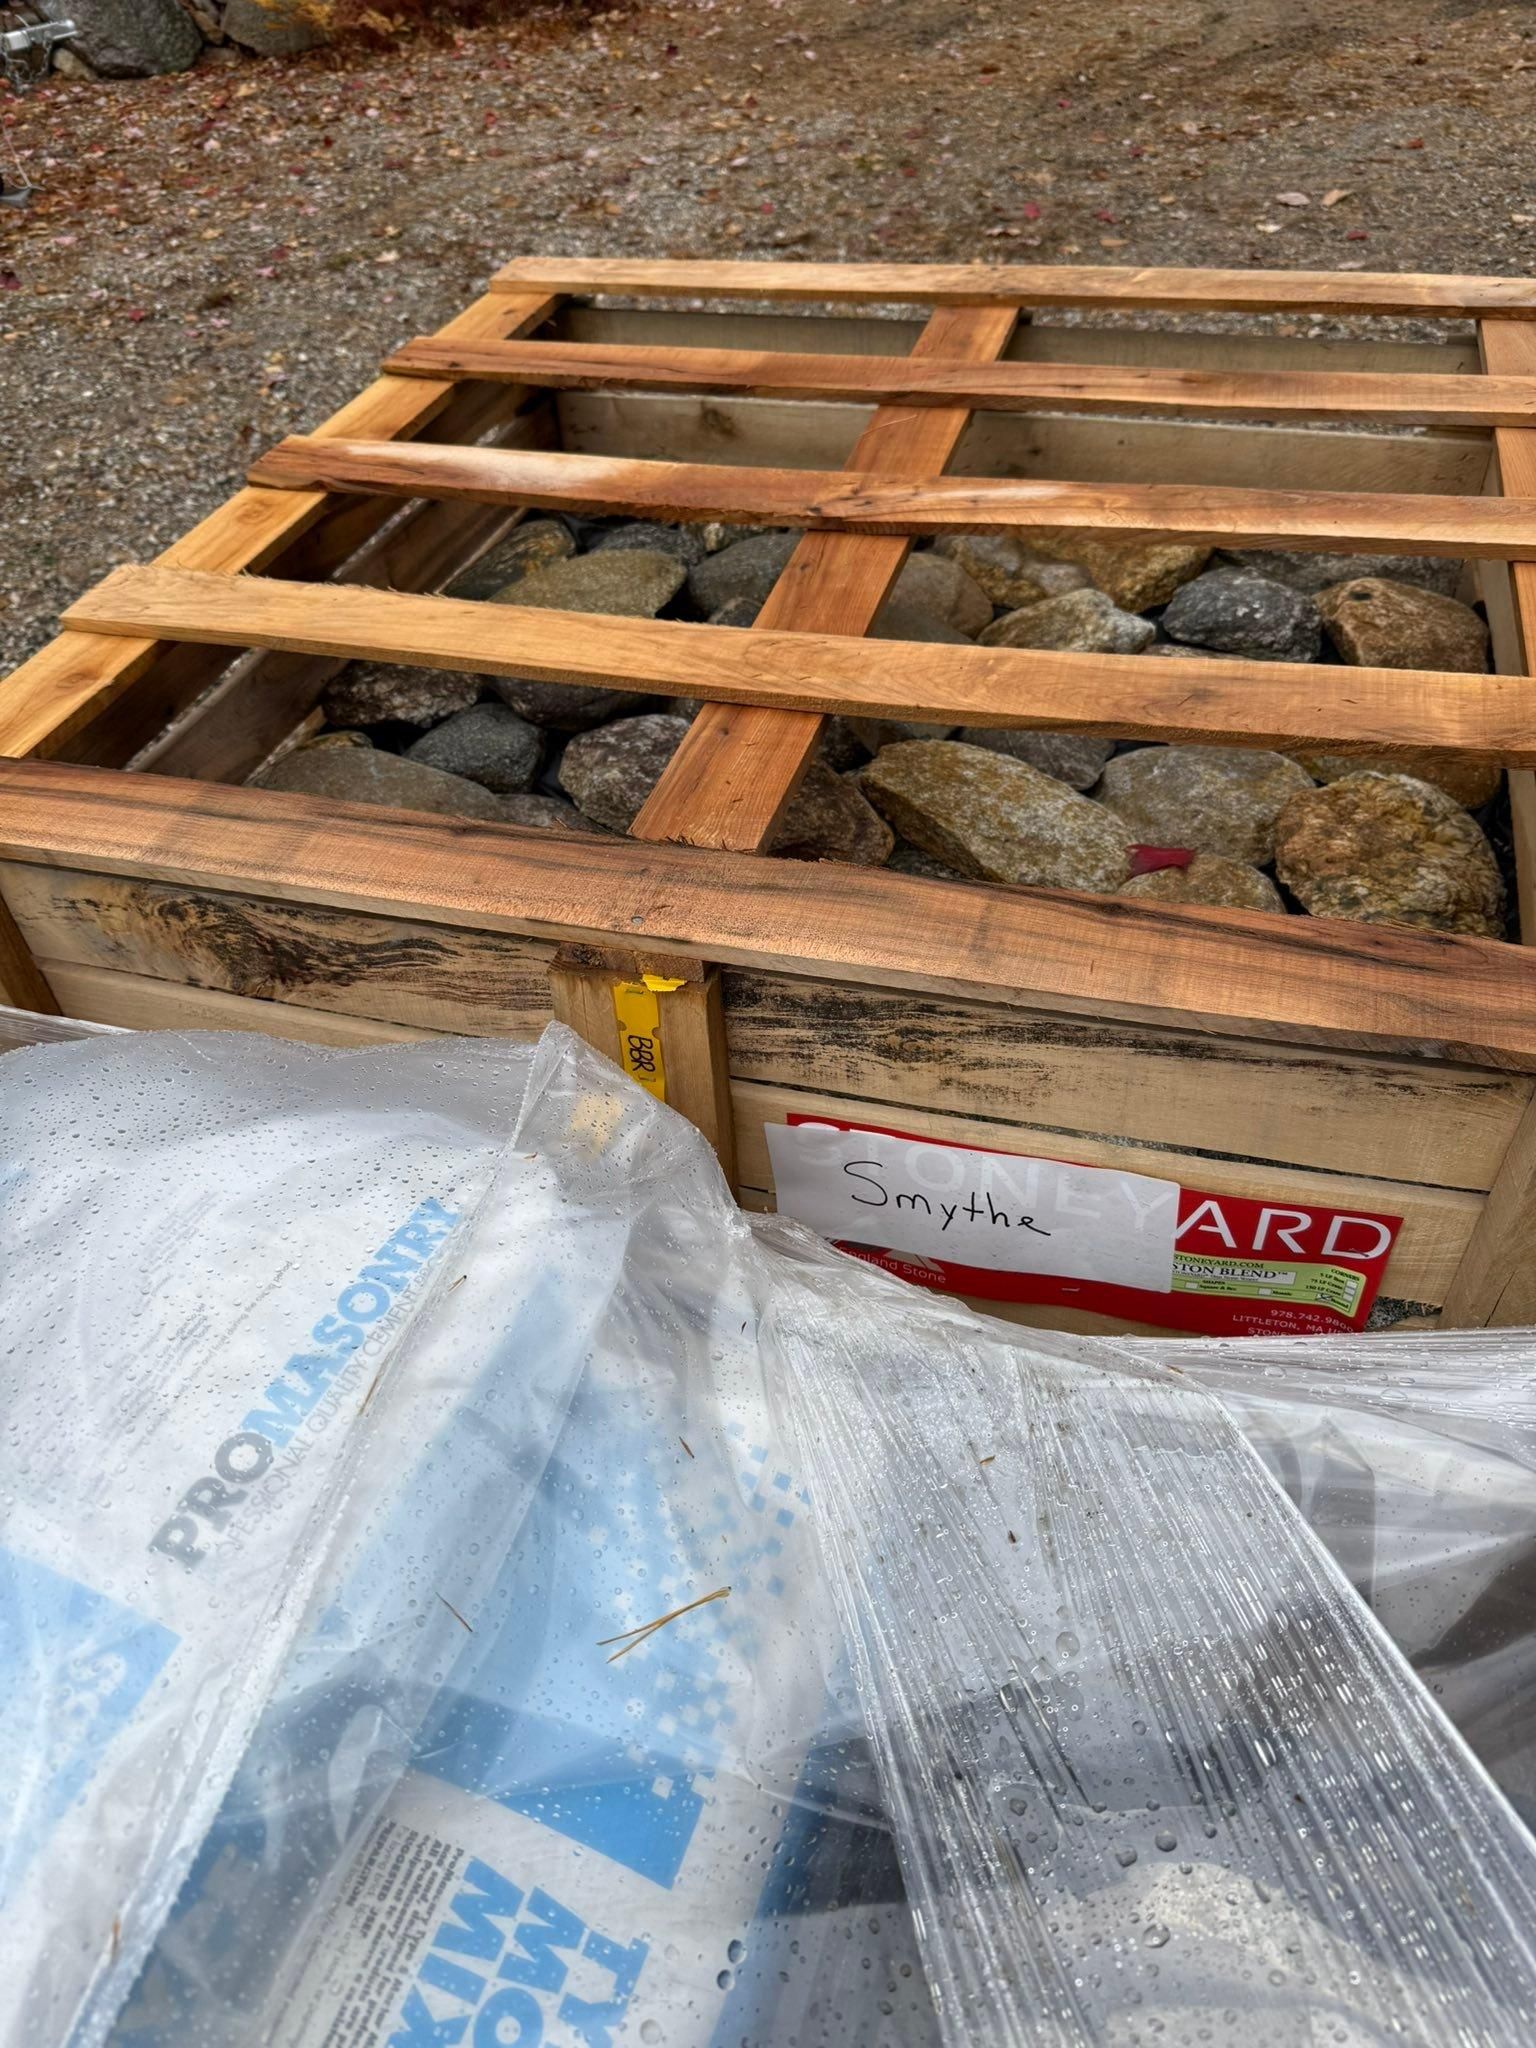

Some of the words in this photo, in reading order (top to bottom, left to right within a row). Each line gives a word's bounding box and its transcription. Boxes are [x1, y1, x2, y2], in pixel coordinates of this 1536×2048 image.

[844, 1160, 1051, 1237] Smythe
[902, 1263, 947, 1284] Stone
[1172, 1263, 1216, 1276] STON
[1330, 1268, 1360, 1280] CORNERS
[1232, 1314, 1301, 1331] LITTLETON,
[1305, 1323, 1324, 1333] MA
[1269, 1308, 1354, 1332] 978.742.9800
[302, 1355, 370, 1437] QUALITY
[357, 1283, 421, 1361] CEMENT
[147, 1197, 463, 1571] PROMASONRY
[344, 1818, 395, 1908] PREPARATION
[375, 1828, 419, 1903] SUGGESTED
[390, 1832, 432, 1903] equipment
[427, 1839, 443, 1859] All
[434, 1842, 453, 1868] and
[384, 1857, 433, 1940] ProMasonry
[415, 1868, 441, 1907] sand,
[417, 1845, 465, 1926] ProMasonry
[383, 1908, 422, 1973] designed
[399, 1926, 427, 1963] Type
[371, 1977, 403, 2029] Mortar
[373, 1974, 391, 1999] for
